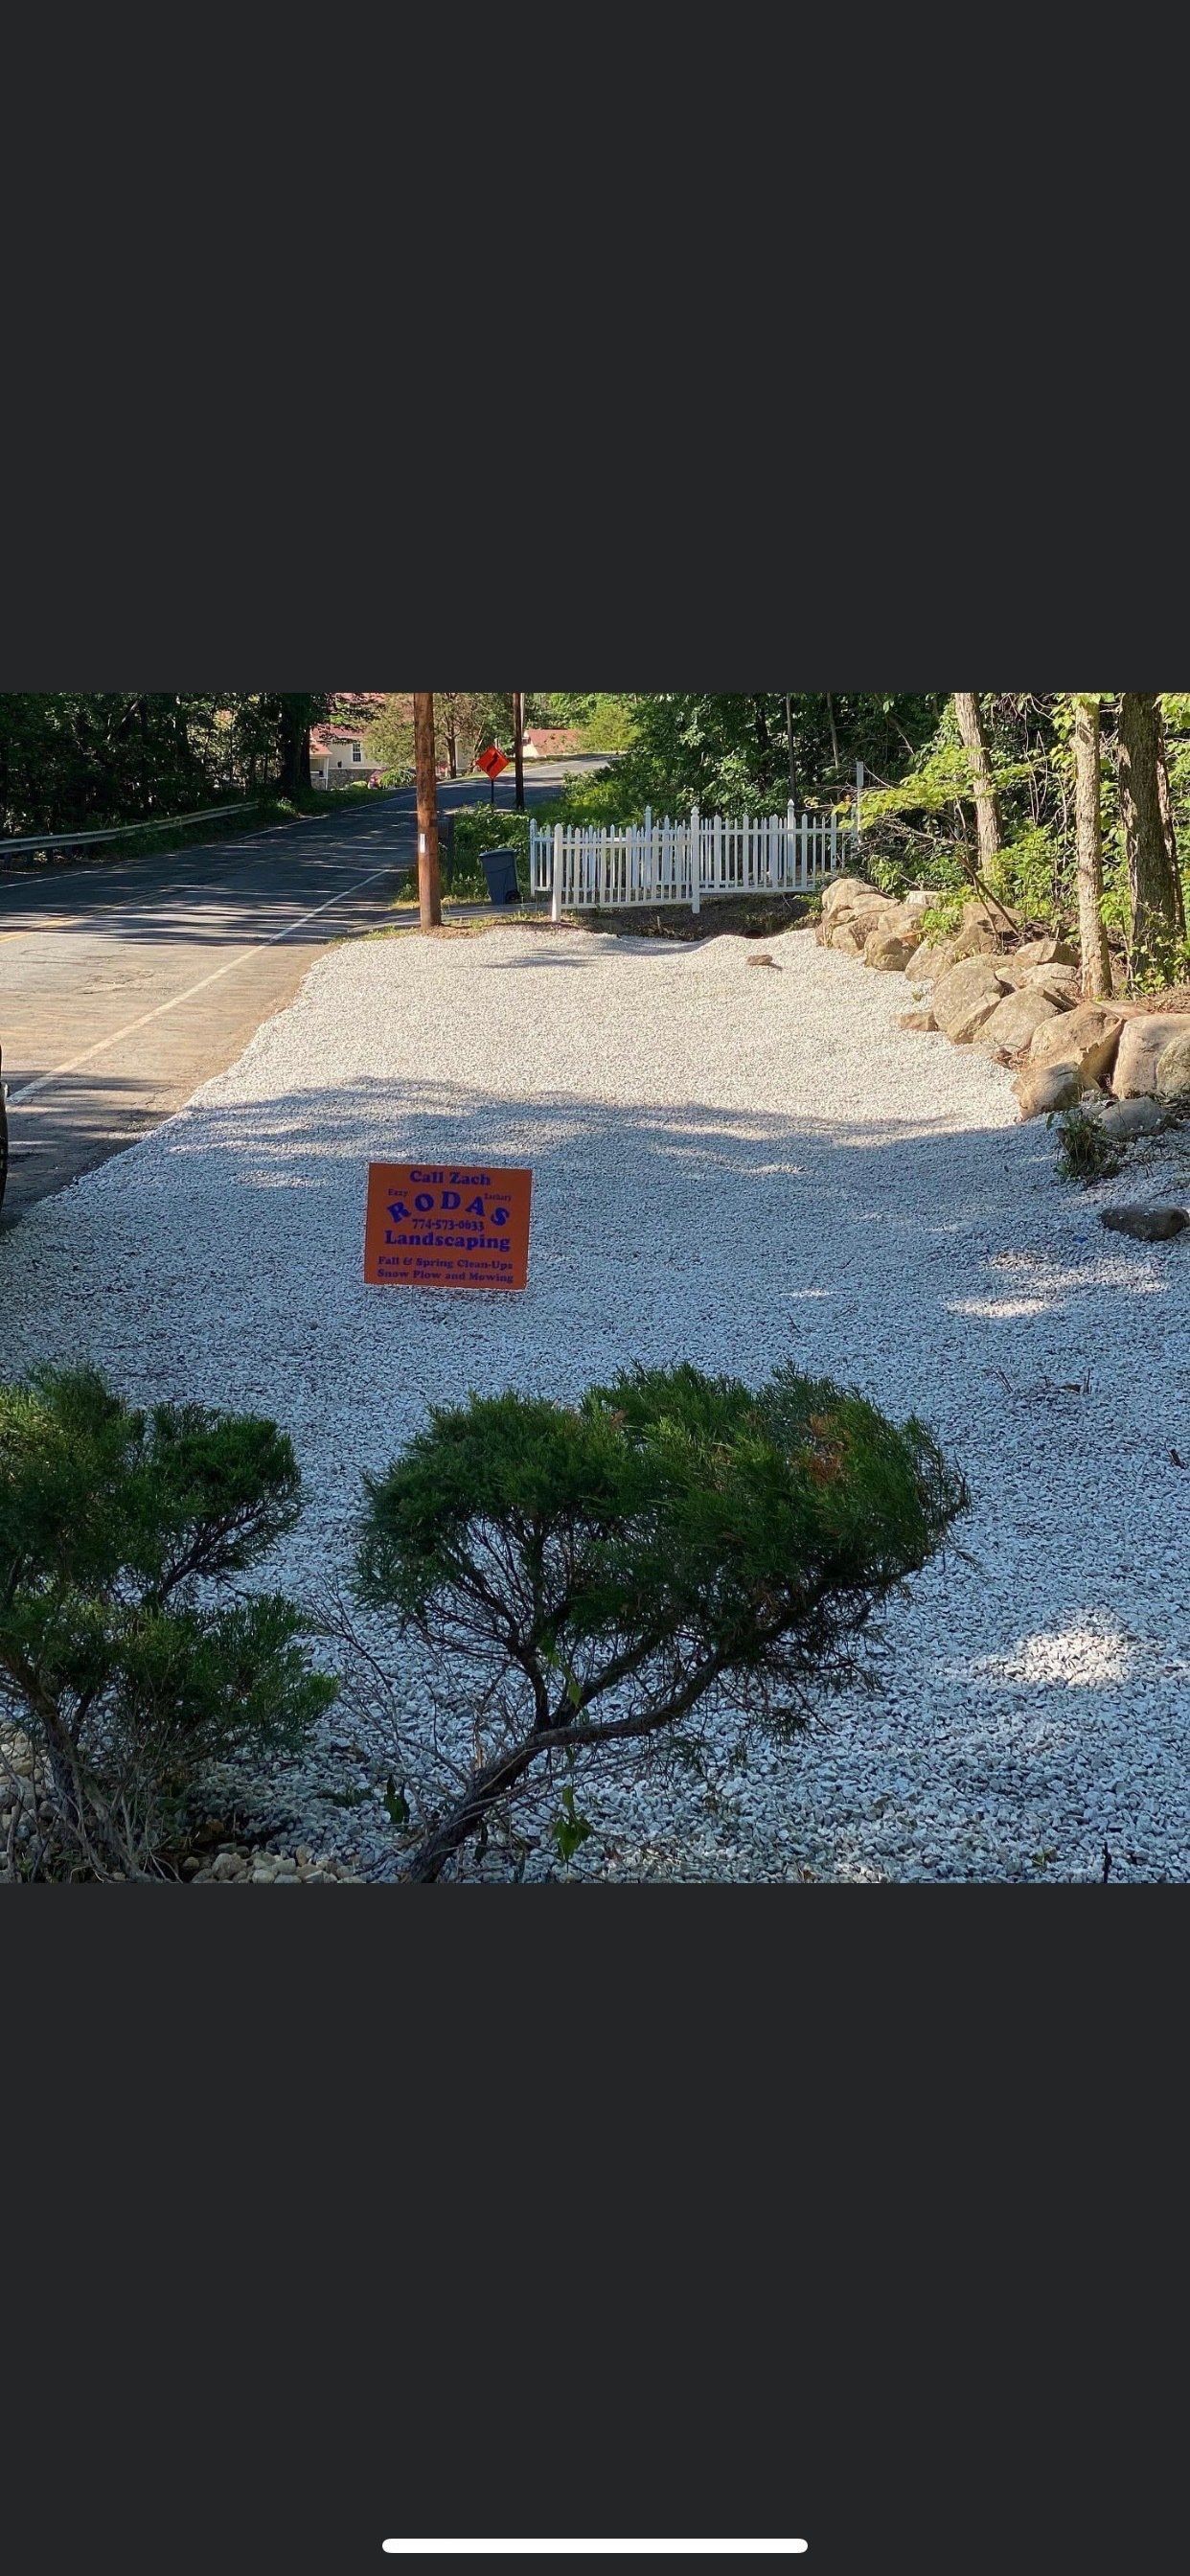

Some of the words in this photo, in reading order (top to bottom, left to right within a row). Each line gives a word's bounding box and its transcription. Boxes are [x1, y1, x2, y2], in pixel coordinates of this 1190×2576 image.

[409, 1170, 444, 1184] Call
[449, 1172, 491, 1185] Zach
[387, 1190, 510, 1226] RODAS
[384, 1230, 511, 1253] Landscaping
[378, 1255, 400, 1265] Fall
[402, 1256, 413, 1266] &
[416, 1257, 453, 1269] Spring
[457, 1258, 513, 1270] Clean-Ups
[378, 1269, 410, 1278] Snow
[413, 1270, 442, 1279] Plow
[446, 1272, 466, 1280] and
[469, 1272, 514, 1283] Mowing
